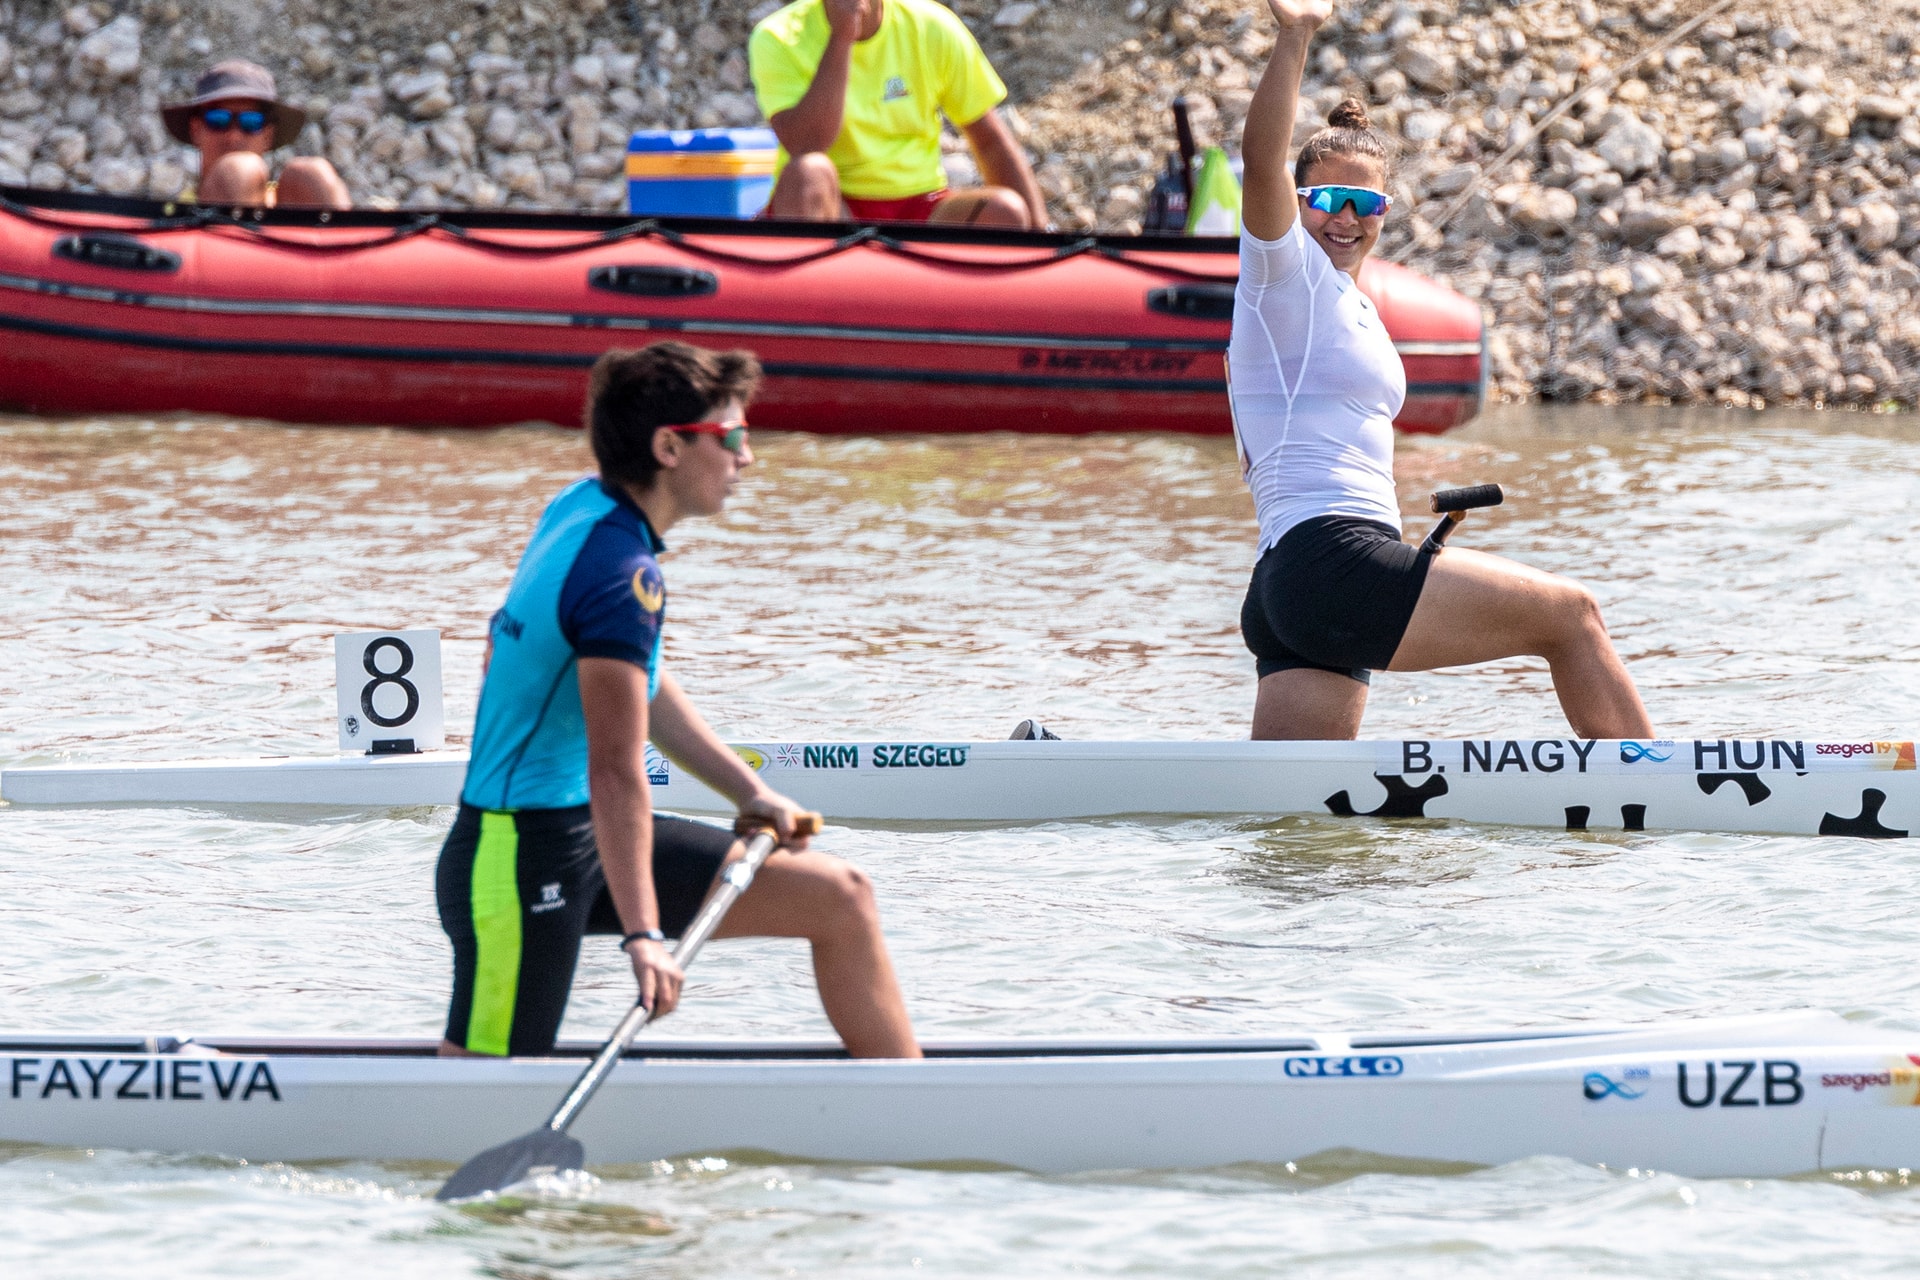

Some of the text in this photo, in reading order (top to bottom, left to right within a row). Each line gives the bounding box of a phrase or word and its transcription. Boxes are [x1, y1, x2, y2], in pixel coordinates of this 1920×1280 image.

[361, 636, 420, 728] 8
[804, 744, 970, 768] NKM SZEGED
[1402, 740, 1597, 774] B. NAGY
[1694, 740, 1805, 770] HUN
[11, 1058, 282, 1101] FAYZIEVA
[1286, 1057, 1401, 1076] NELO
[1677, 1060, 1804, 1108] UZB
